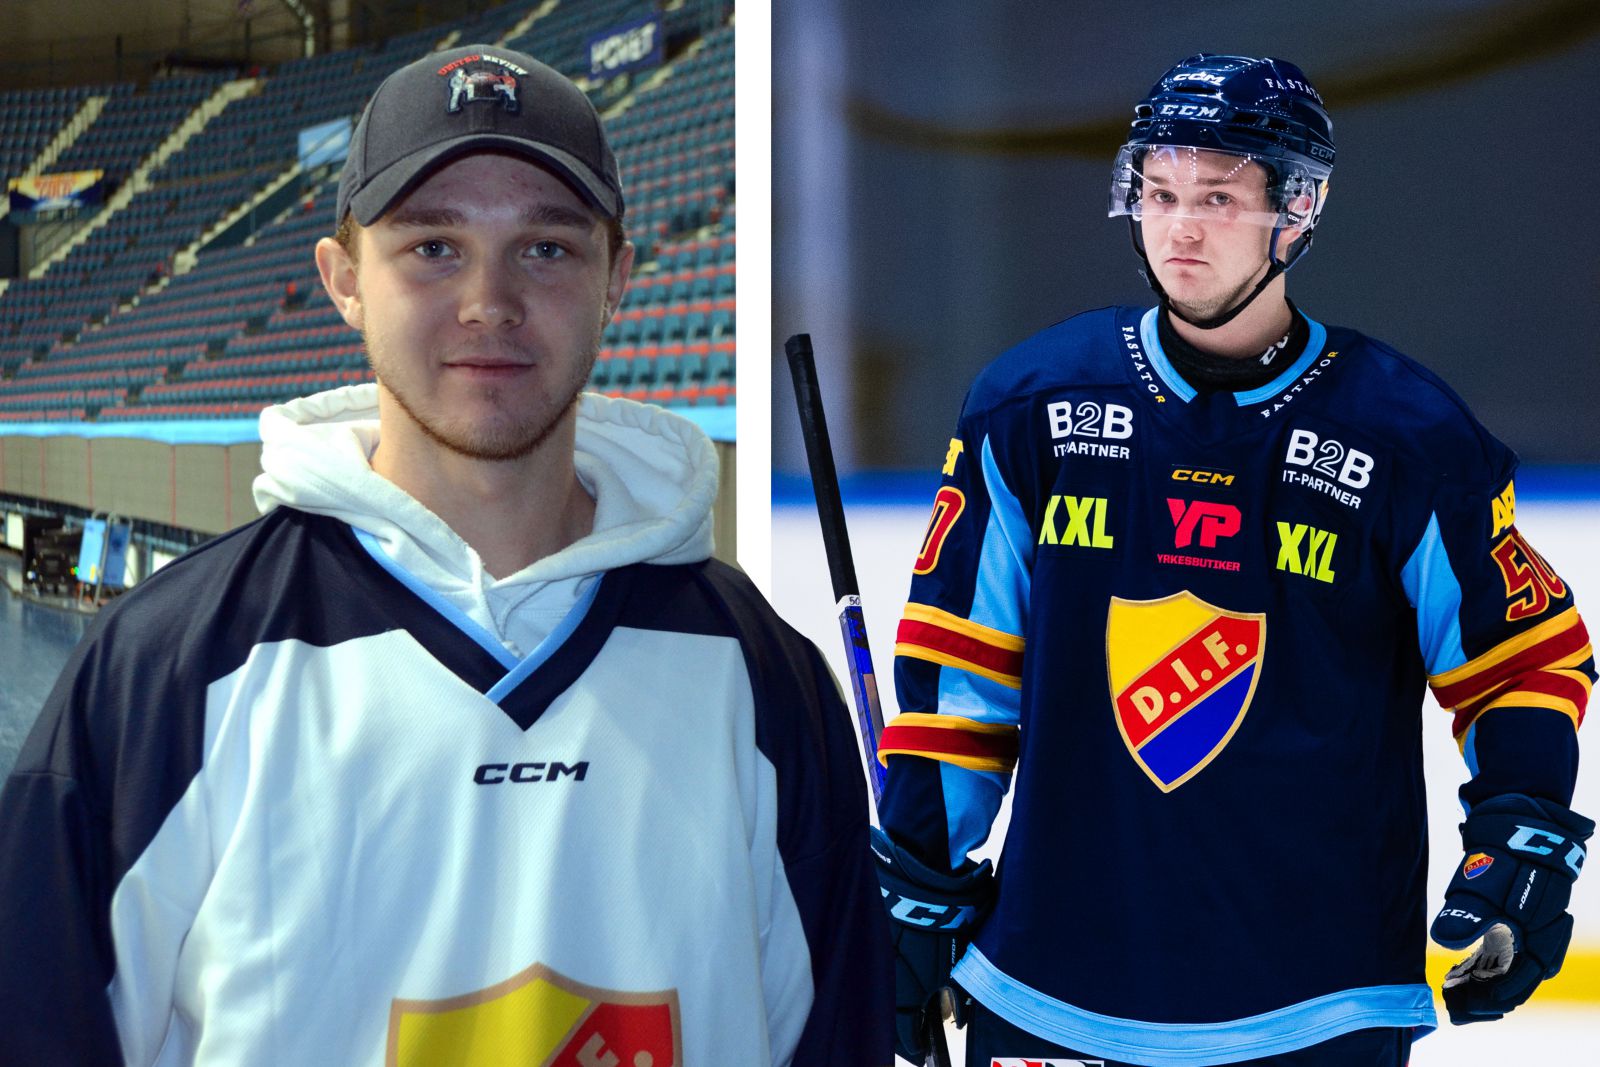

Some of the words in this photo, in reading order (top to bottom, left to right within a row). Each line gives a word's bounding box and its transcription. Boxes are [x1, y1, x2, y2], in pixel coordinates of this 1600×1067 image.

[437, 54, 480, 76] UNITED
[482, 54, 528, 75] REVIEW
[1310, 145, 1334, 161] CCM
[1122, 326, 1166, 403] FASTATOR
[1260, 351, 1340, 418] FASTATOR
[1047, 401, 1134, 440] B2B
[1171, 469, 1236, 486] CCM
[1285, 428, 1375, 489] B2B
[1282, 469, 1362, 509] IT-PARTNER
[1166, 498, 1242, 549] YP
[1157, 553, 1241, 572] YRKESBUTIKER
[1276, 521, 1339, 584] XXL
[1129, 630, 1248, 726] D.I.F.
[473, 761, 590, 785] CCM
[1439, 908, 1482, 924] CCM
